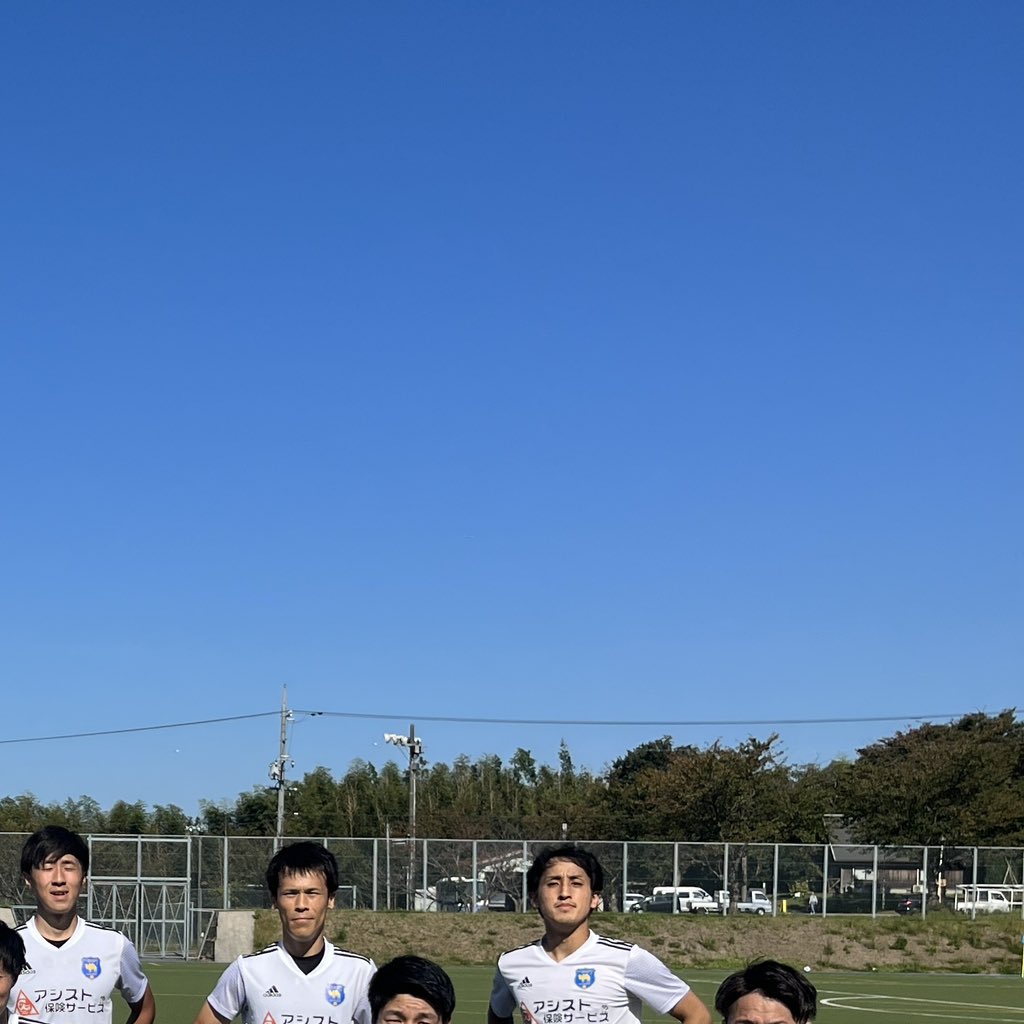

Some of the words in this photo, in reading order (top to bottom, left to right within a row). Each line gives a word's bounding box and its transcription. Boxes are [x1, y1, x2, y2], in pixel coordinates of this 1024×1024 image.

[34, 989, 93, 1003] アシスト
[45, 1002, 105, 1014] 保険サービス
[533, 999, 591, 1014] アシスト
[543, 1012, 610, 1024] 保険サービス
